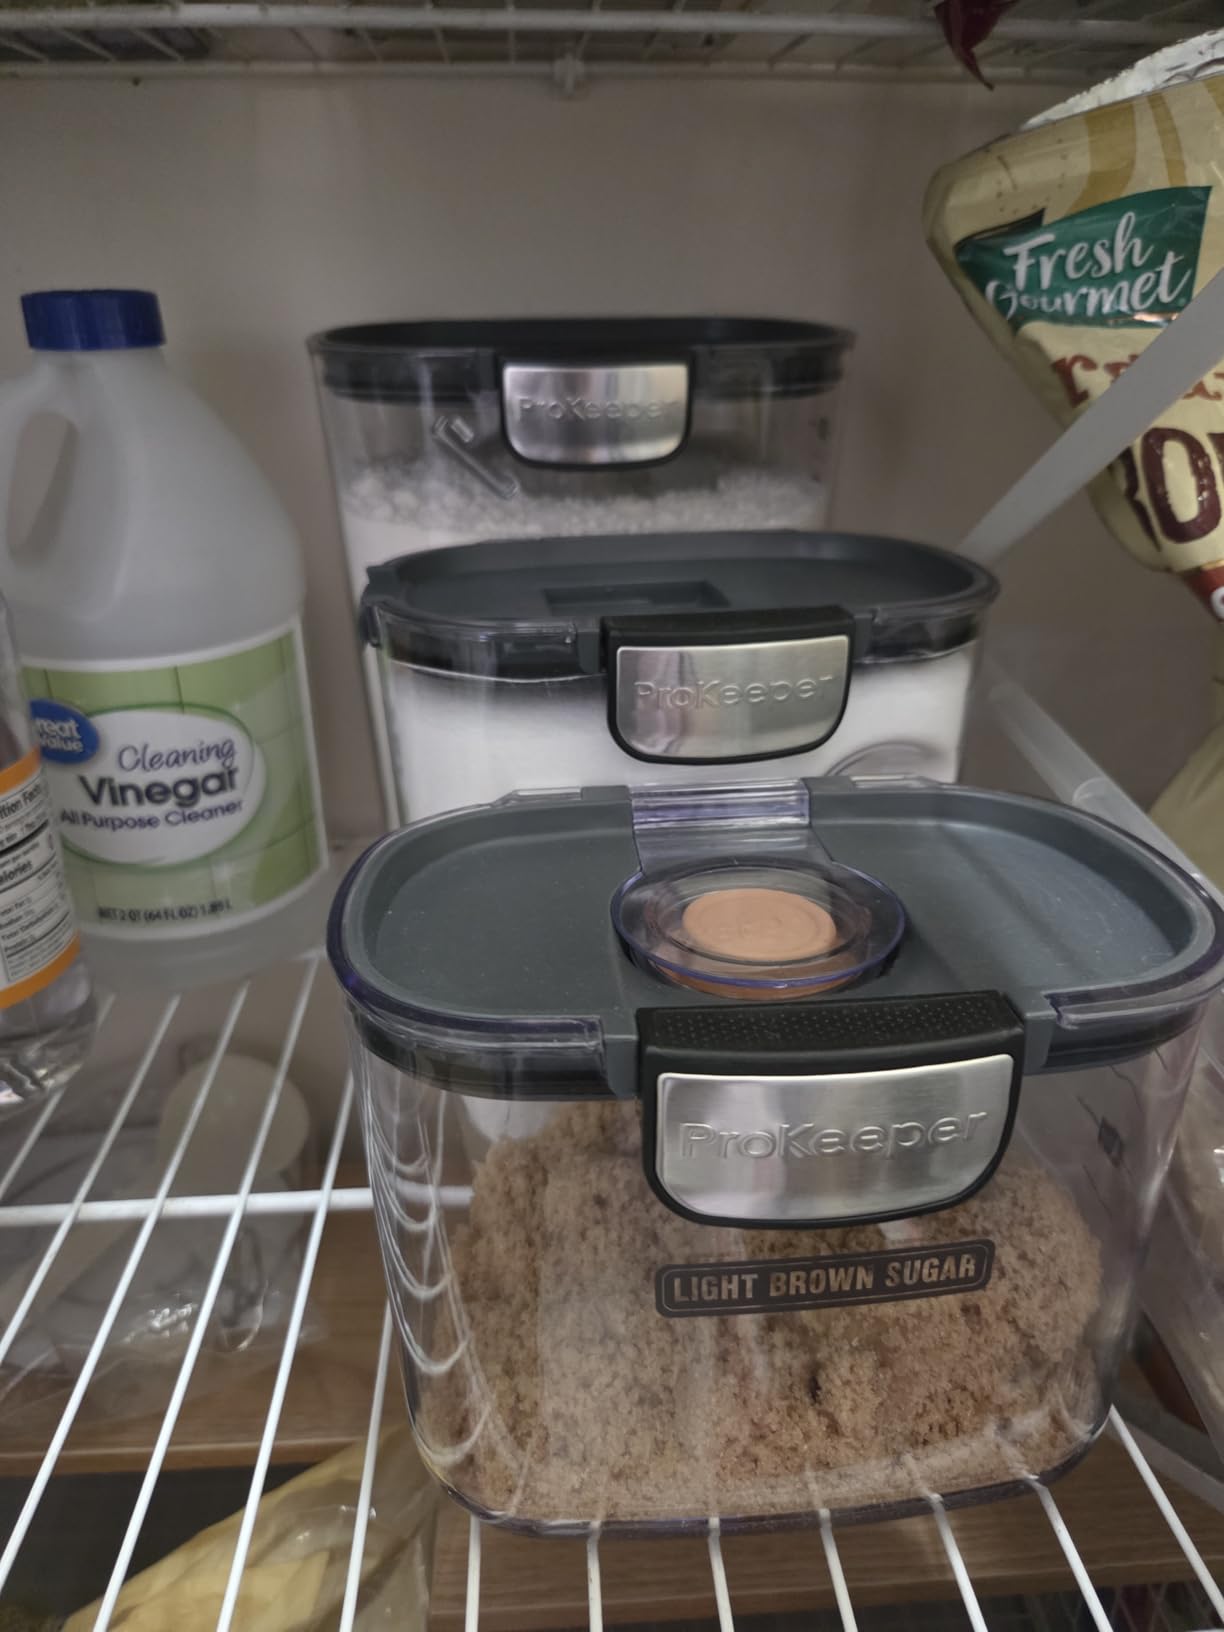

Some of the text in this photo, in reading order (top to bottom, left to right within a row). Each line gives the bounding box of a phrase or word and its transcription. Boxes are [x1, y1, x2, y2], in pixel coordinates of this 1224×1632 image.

[1003, 211, 1154, 291] Fresh
[985, 251, 1192, 320] Gourmet
[515, 394, 680, 422] ProKeeper
[633, 673, 834, 710] ProKeeper
[36, 718, 81, 738] reat
[117, 738, 235, 773] Cleaning
[78, 767, 239, 809] Vinegar
[60, 799, 243, 831] All Purpose Cleaner
[0, 861, 33, 885] alories
[679, 1110, 988, 1159] ProKeeper
[673, 1252, 977, 1301] LIGHT BROWN SUGAR
